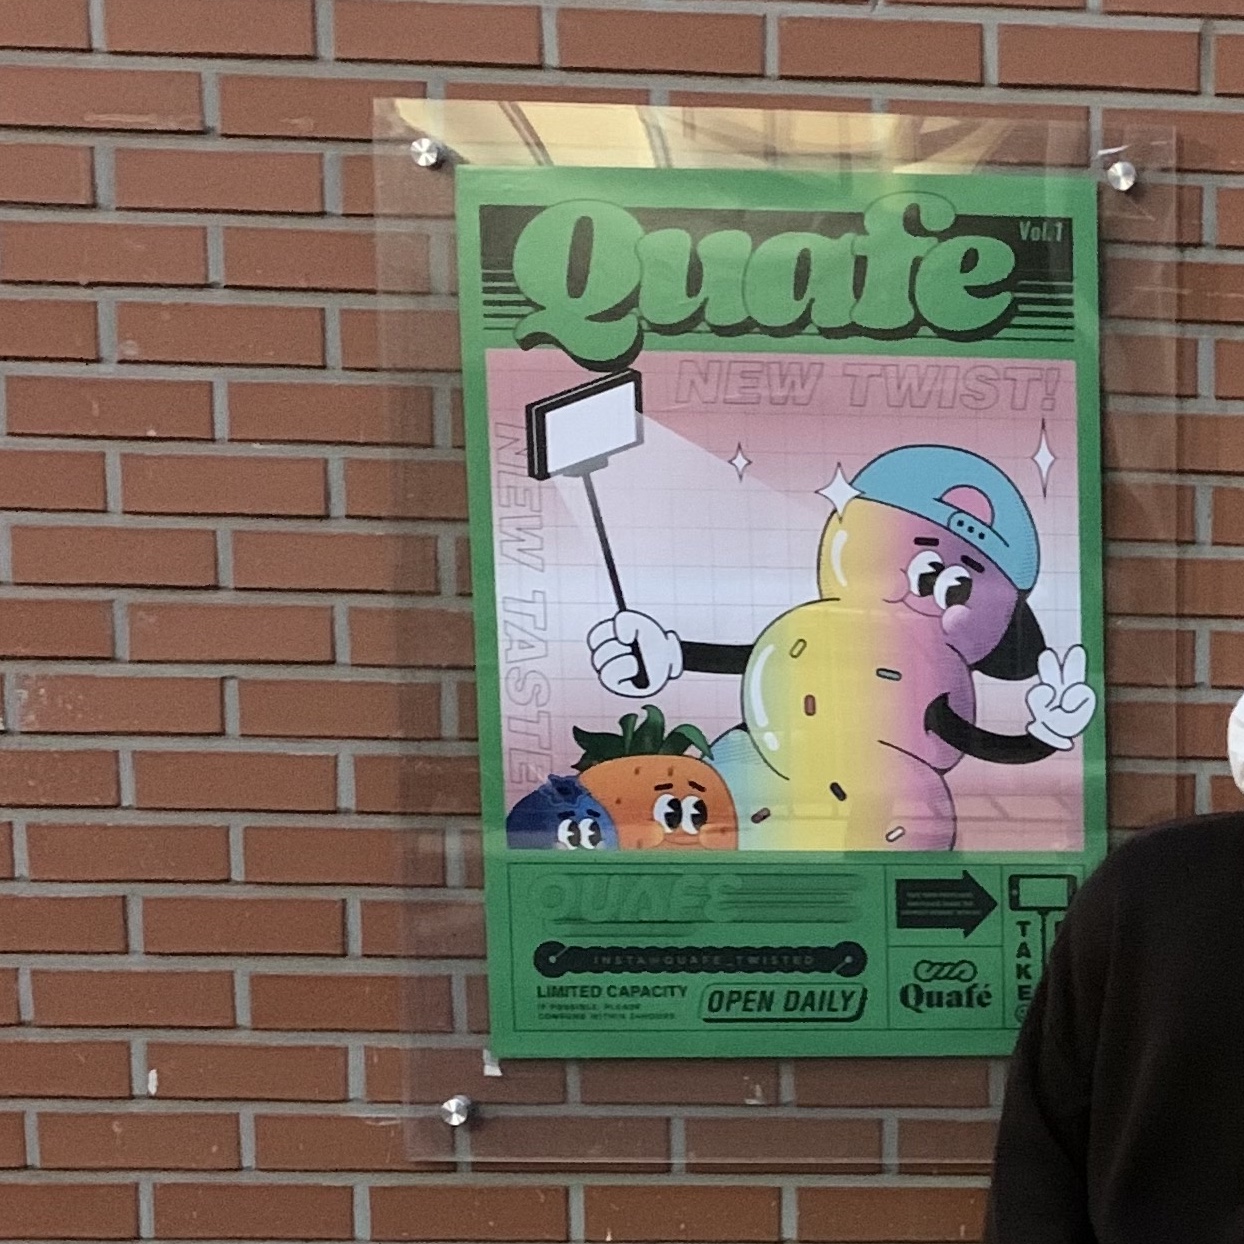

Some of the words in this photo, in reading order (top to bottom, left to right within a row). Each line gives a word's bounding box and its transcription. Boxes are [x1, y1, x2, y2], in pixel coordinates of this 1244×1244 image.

[1019, 220, 1063, 242] Vol.1
[512, 190, 1017, 372] Quafe
[675, 359, 824, 407] NEW
[843, 362, 1061, 412] TWIST!
[494, 421, 545, 573] NEW
[502, 589, 552, 785] TASTE
[1015, 920, 1033, 1001] TAKE
[536, 984, 602, 998] LIMITED
[606, 984, 688, 998] CAPACITY
[707, 989, 775, 1013] OPEN
[783, 989, 856, 1012] DAILY
[899, 982, 993, 1014] Quafé
